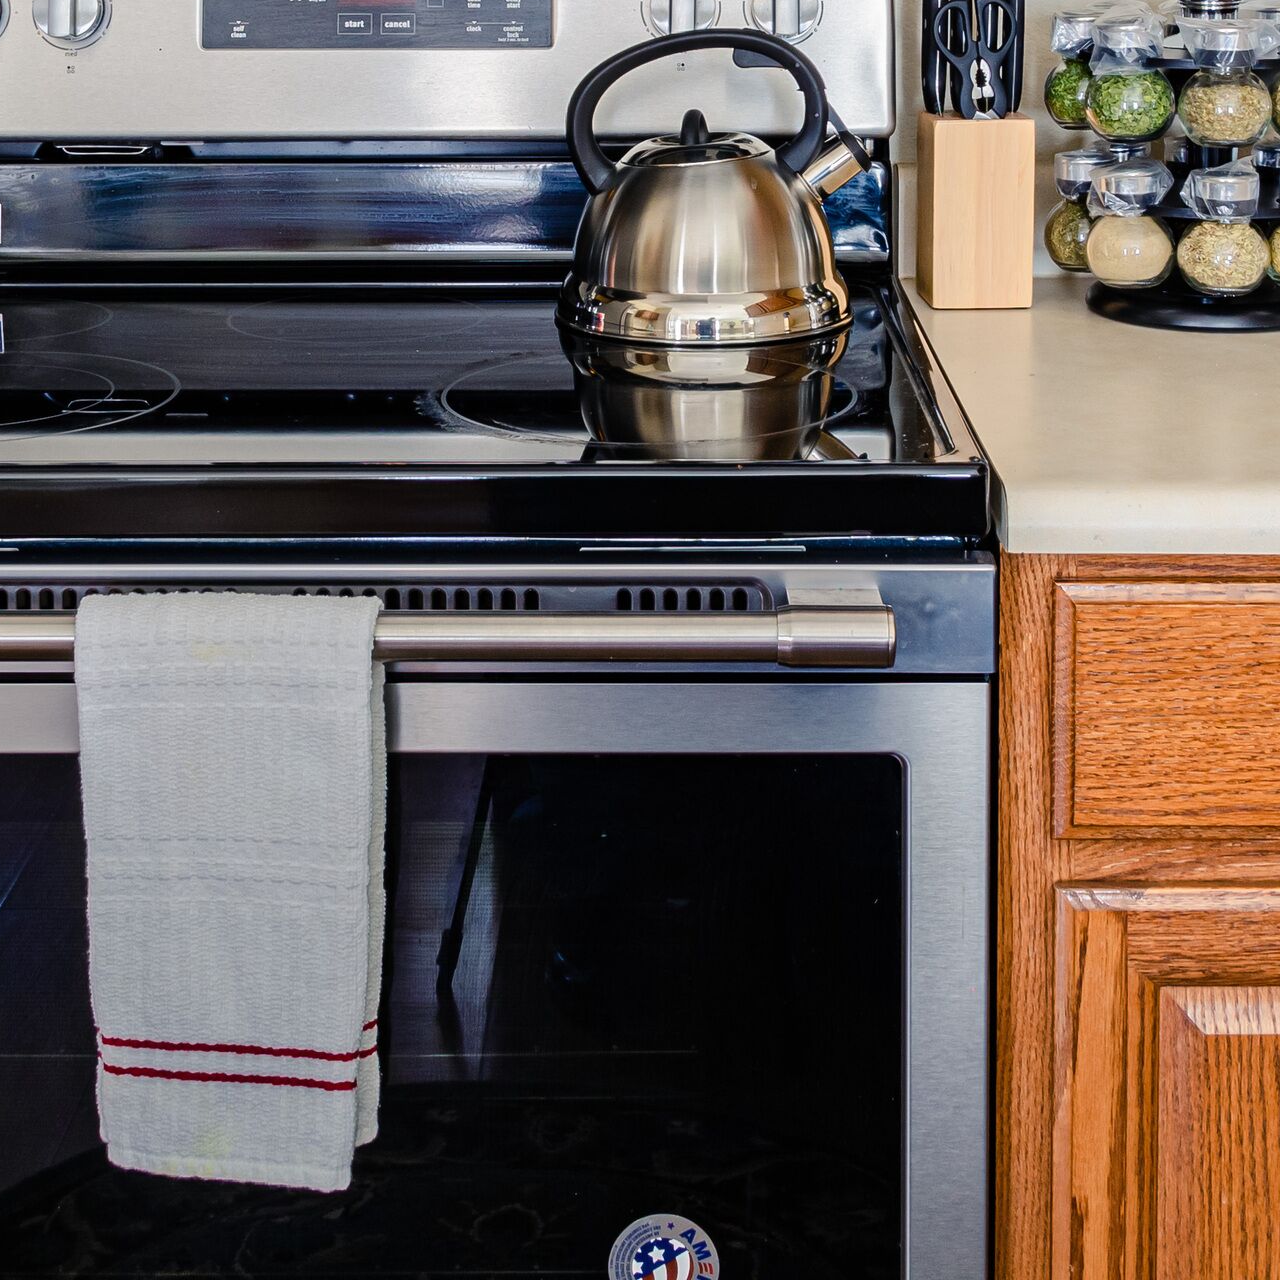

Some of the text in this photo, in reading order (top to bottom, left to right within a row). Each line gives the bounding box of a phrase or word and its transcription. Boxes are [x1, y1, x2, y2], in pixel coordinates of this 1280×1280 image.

[344, 20, 365, 28] start
[384, 20, 410, 28] cancel
[679, 1227, 715, 1280] AME
